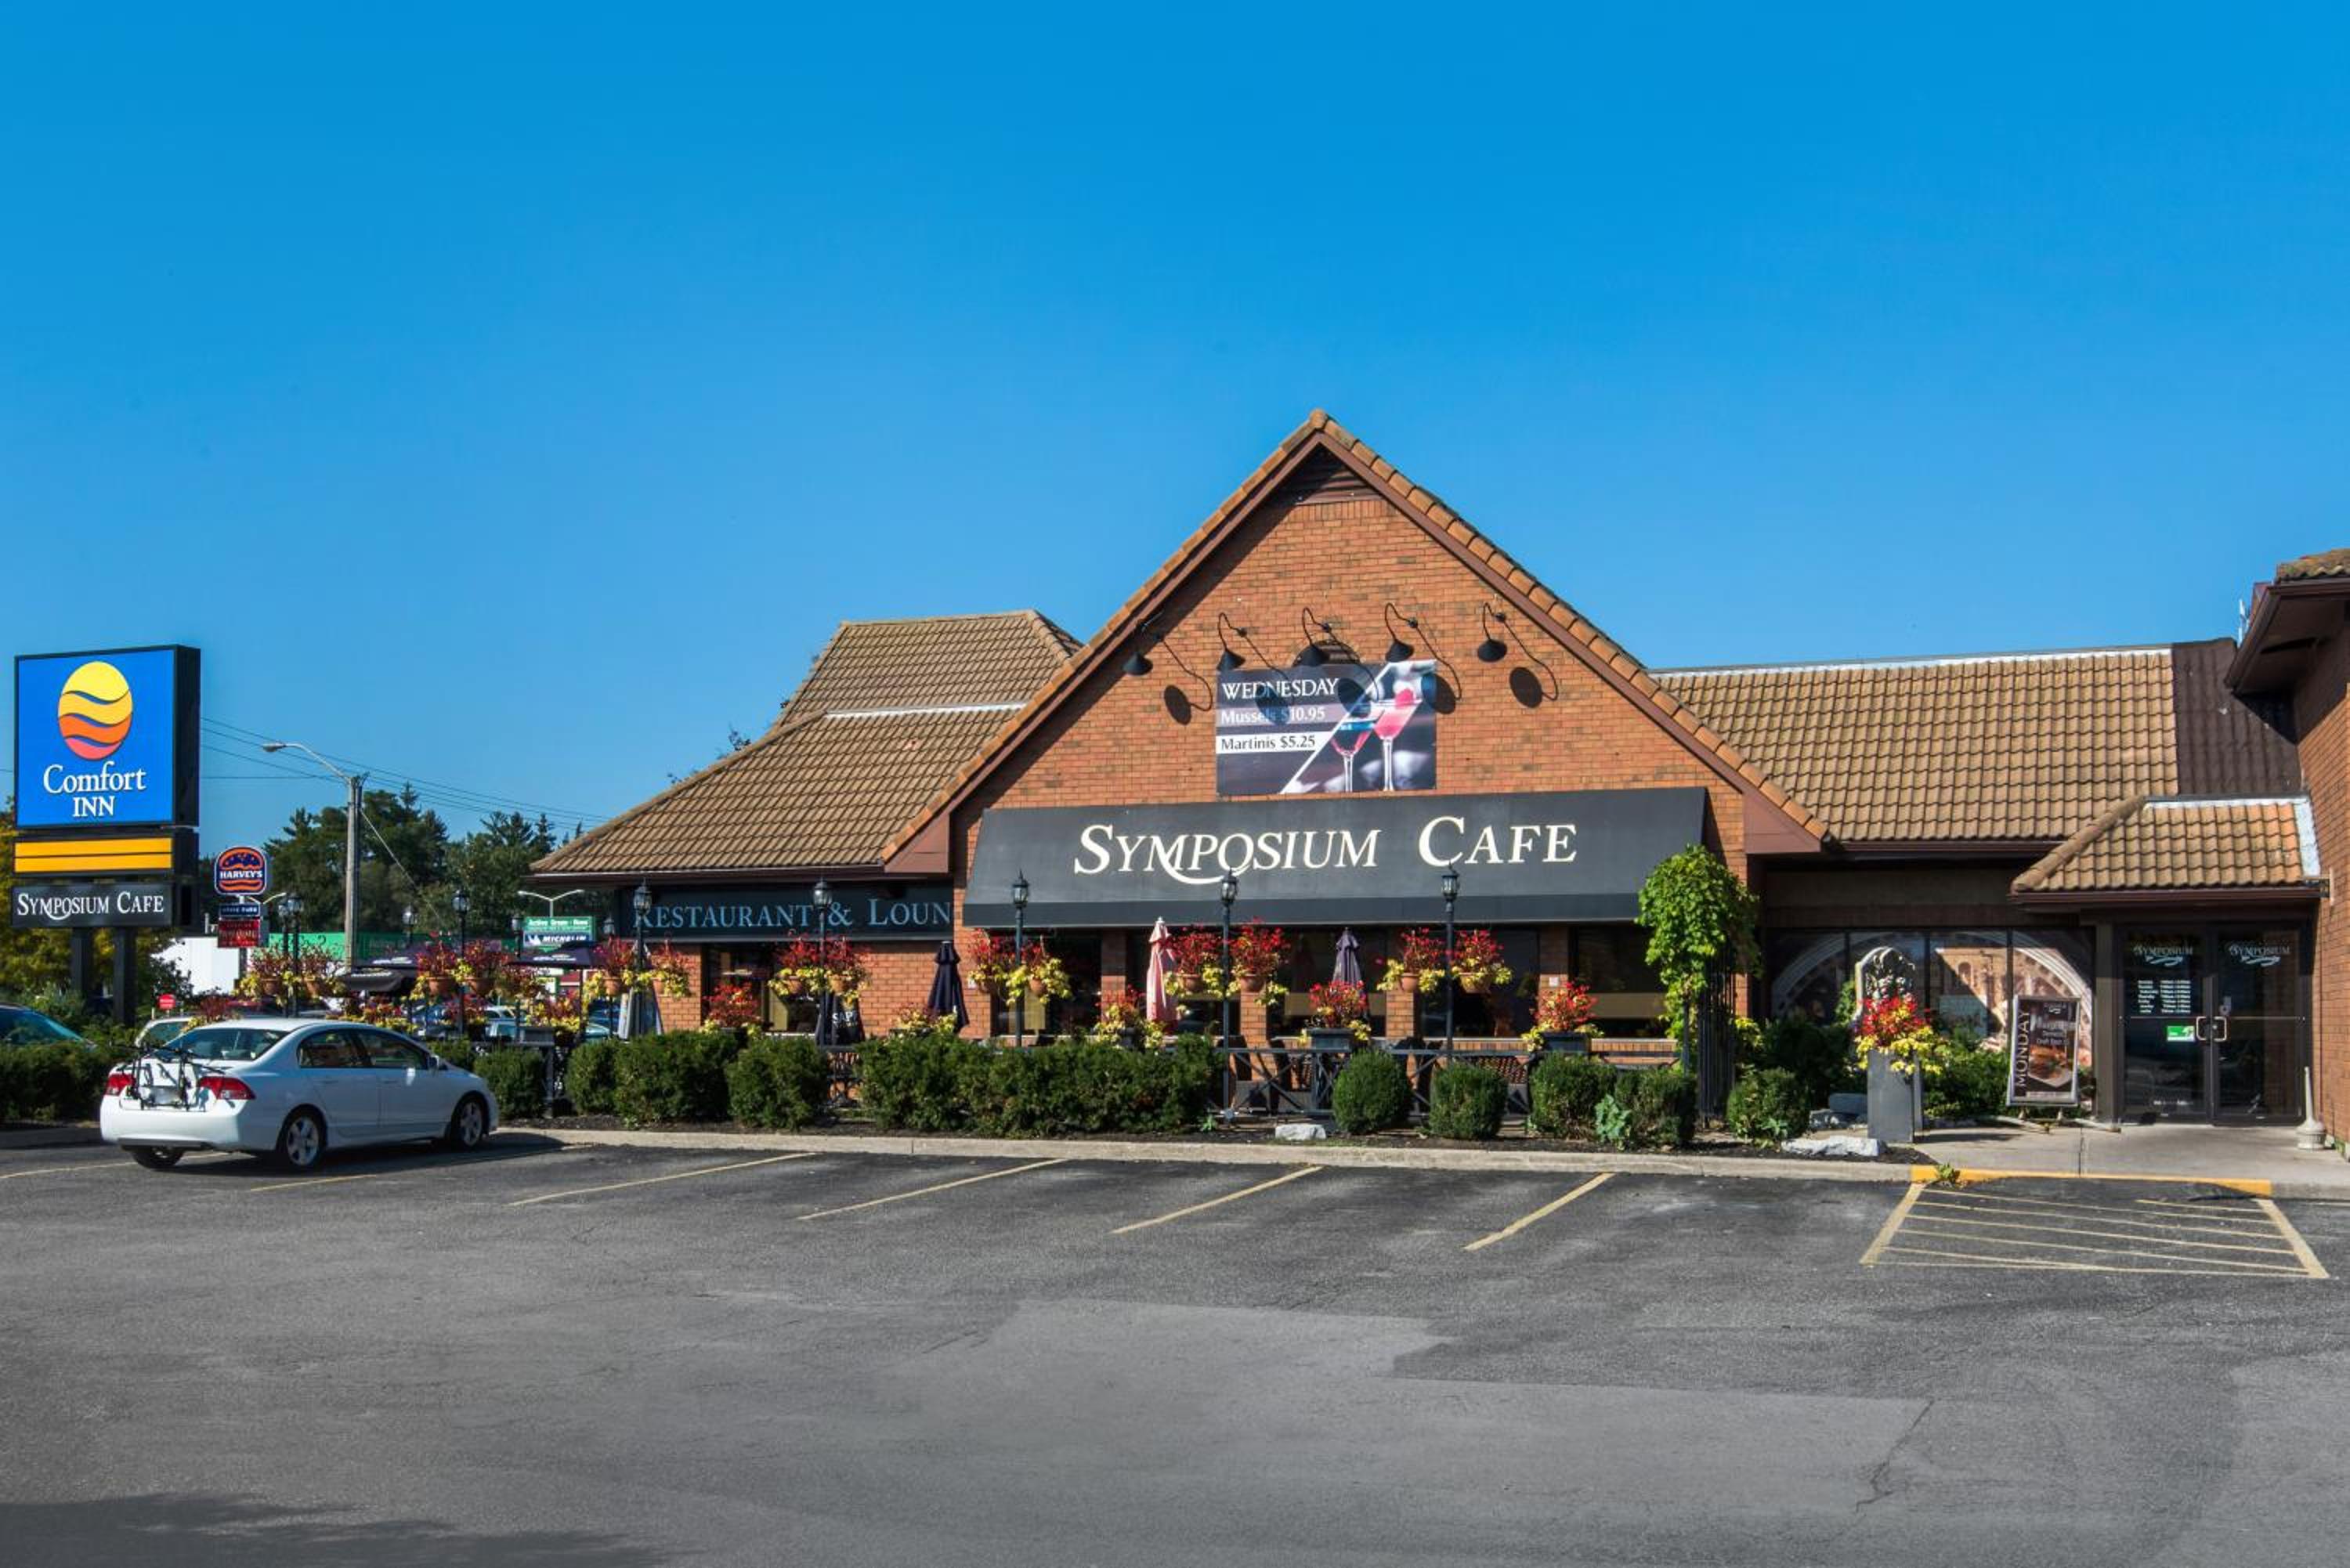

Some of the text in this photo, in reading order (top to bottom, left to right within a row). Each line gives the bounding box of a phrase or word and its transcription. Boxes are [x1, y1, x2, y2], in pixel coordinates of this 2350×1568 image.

[1221, 677, 1340, 700] WEDNESDAY
[1220, 705, 1326, 724] Mussels $10.95
[1220, 735, 1315, 750] Martinis $5.25
[43, 760, 147, 794] Comfort
[72, 795, 116, 818] INN
[1074, 815, 1578, 885] SYMPOSIUM CAFE
[219, 869, 263, 879] HARVEY'S
[17, 891, 164, 921] SYMPOSIUM CAFE
[828, 901, 853, 927] &
[867, 898, 951, 926] LOUN
[2016, 1010, 2030, 1087] MONDAY
